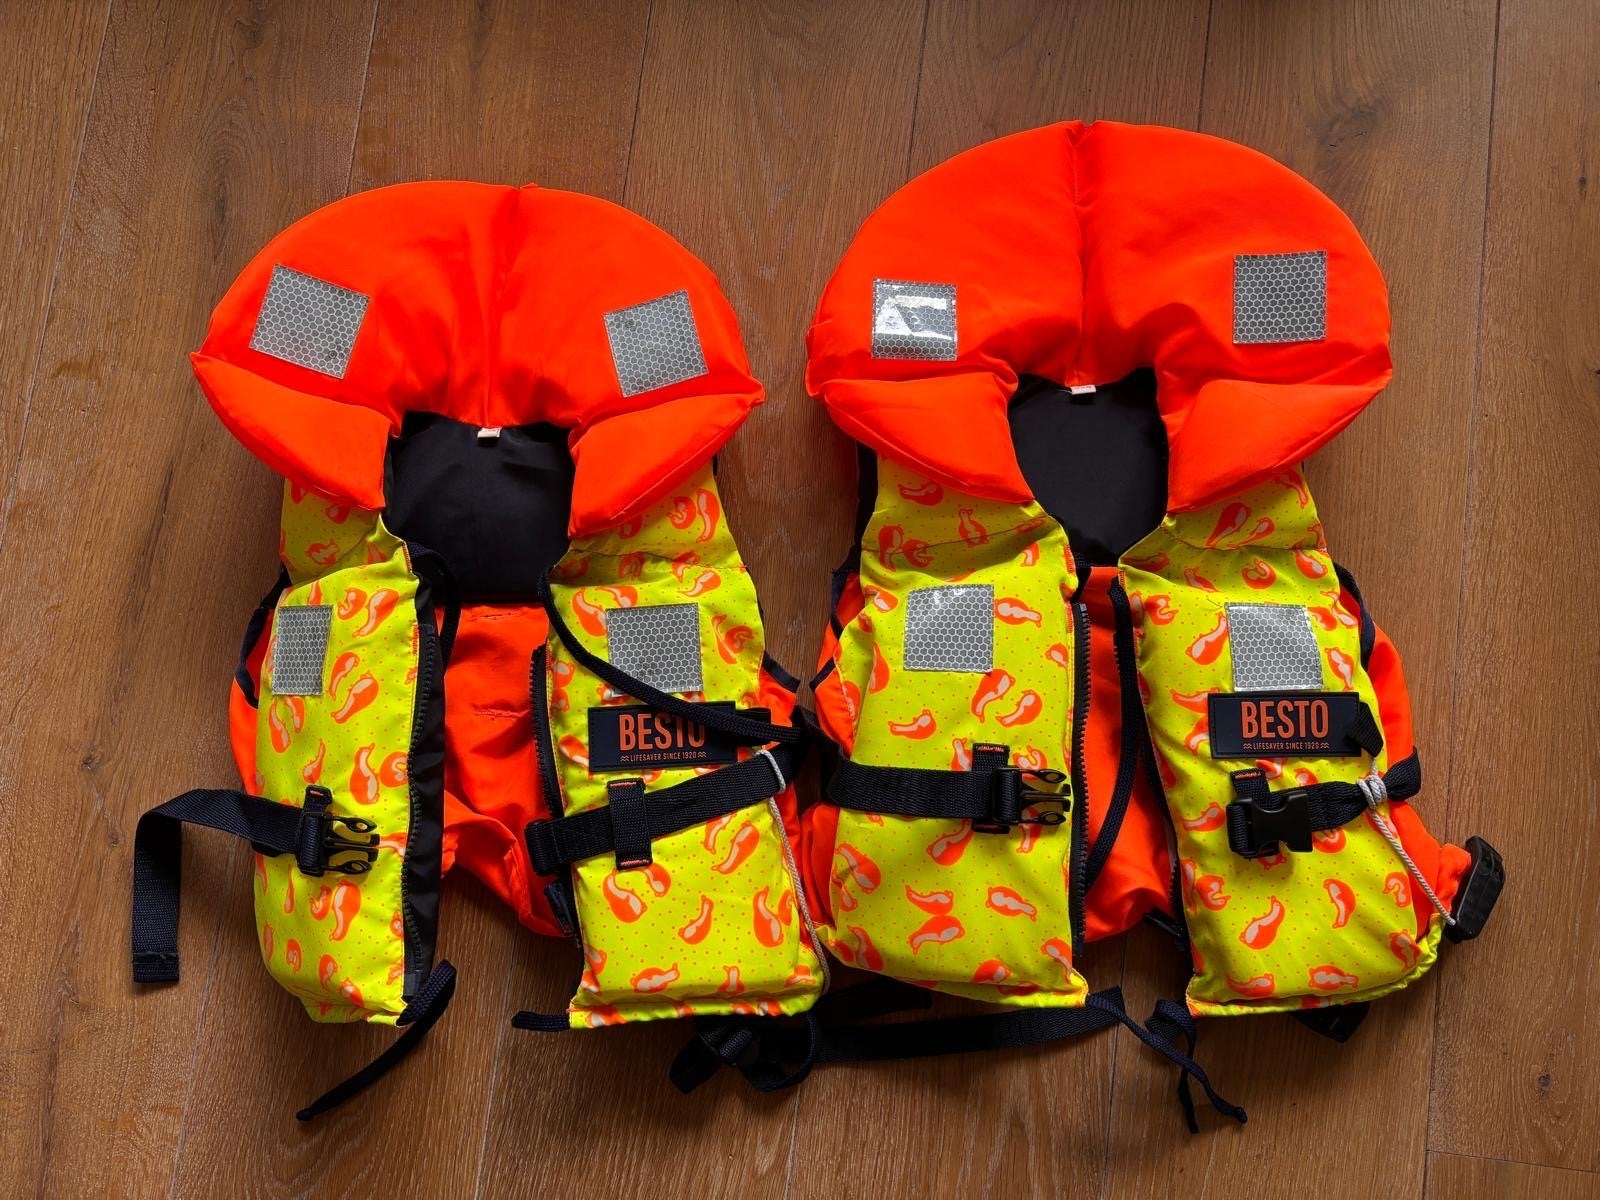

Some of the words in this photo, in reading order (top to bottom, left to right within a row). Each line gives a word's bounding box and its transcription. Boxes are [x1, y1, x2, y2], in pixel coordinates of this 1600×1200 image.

[1241, 699, 1329, 739] BESTO
[1253, 742, 1284, 750] LIFESAVER
[1286, 742, 1303, 750] SINCE
[1305, 742, 1320, 750] 1920
[630, 753, 661, 762] LIFESAVER
[663, 752, 681, 760] SINCE
[682, 751, 697, 759] 1920
